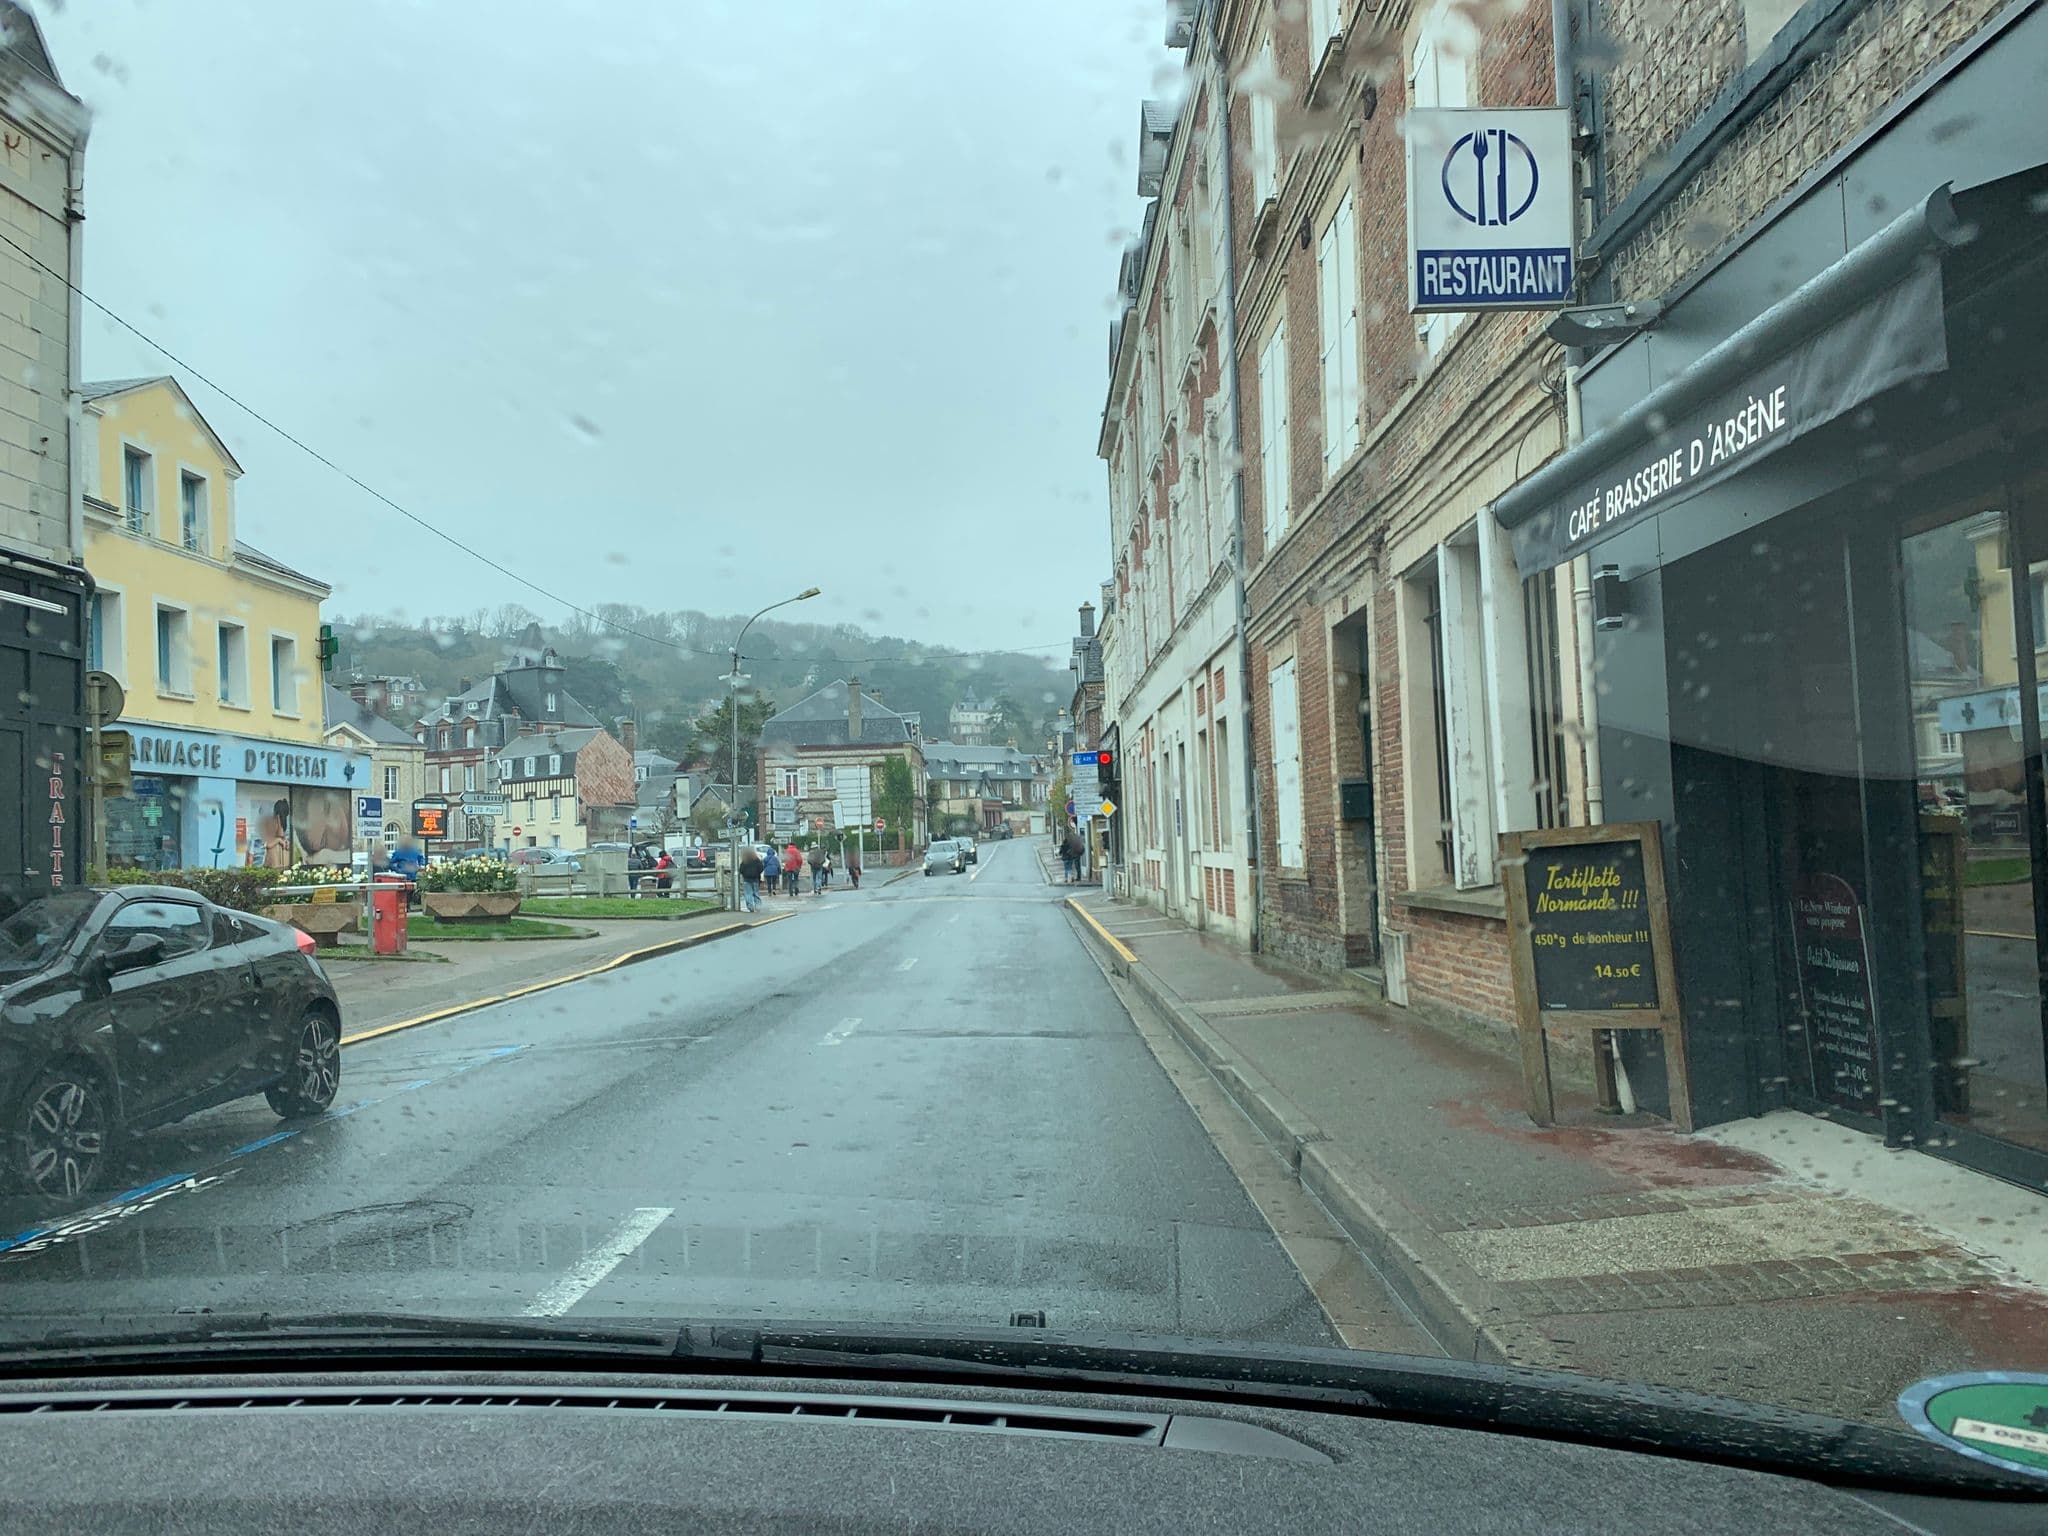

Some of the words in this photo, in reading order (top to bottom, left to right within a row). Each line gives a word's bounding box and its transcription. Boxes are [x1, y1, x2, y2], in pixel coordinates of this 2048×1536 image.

[1422, 253, 1567, 298] RESTAURANT
[1568, 490, 1600, 542] CAFÉ
[1605, 448, 1683, 523] BRASSERIE
[244, 748, 328, 779] D'ETRETAT
[1546, 865, 1622, 896] Tartiflette
[1535, 888, 1616, 914] Normande
[1572, 932, 1584, 944] de
[1587, 931, 1632, 944] bonheur
